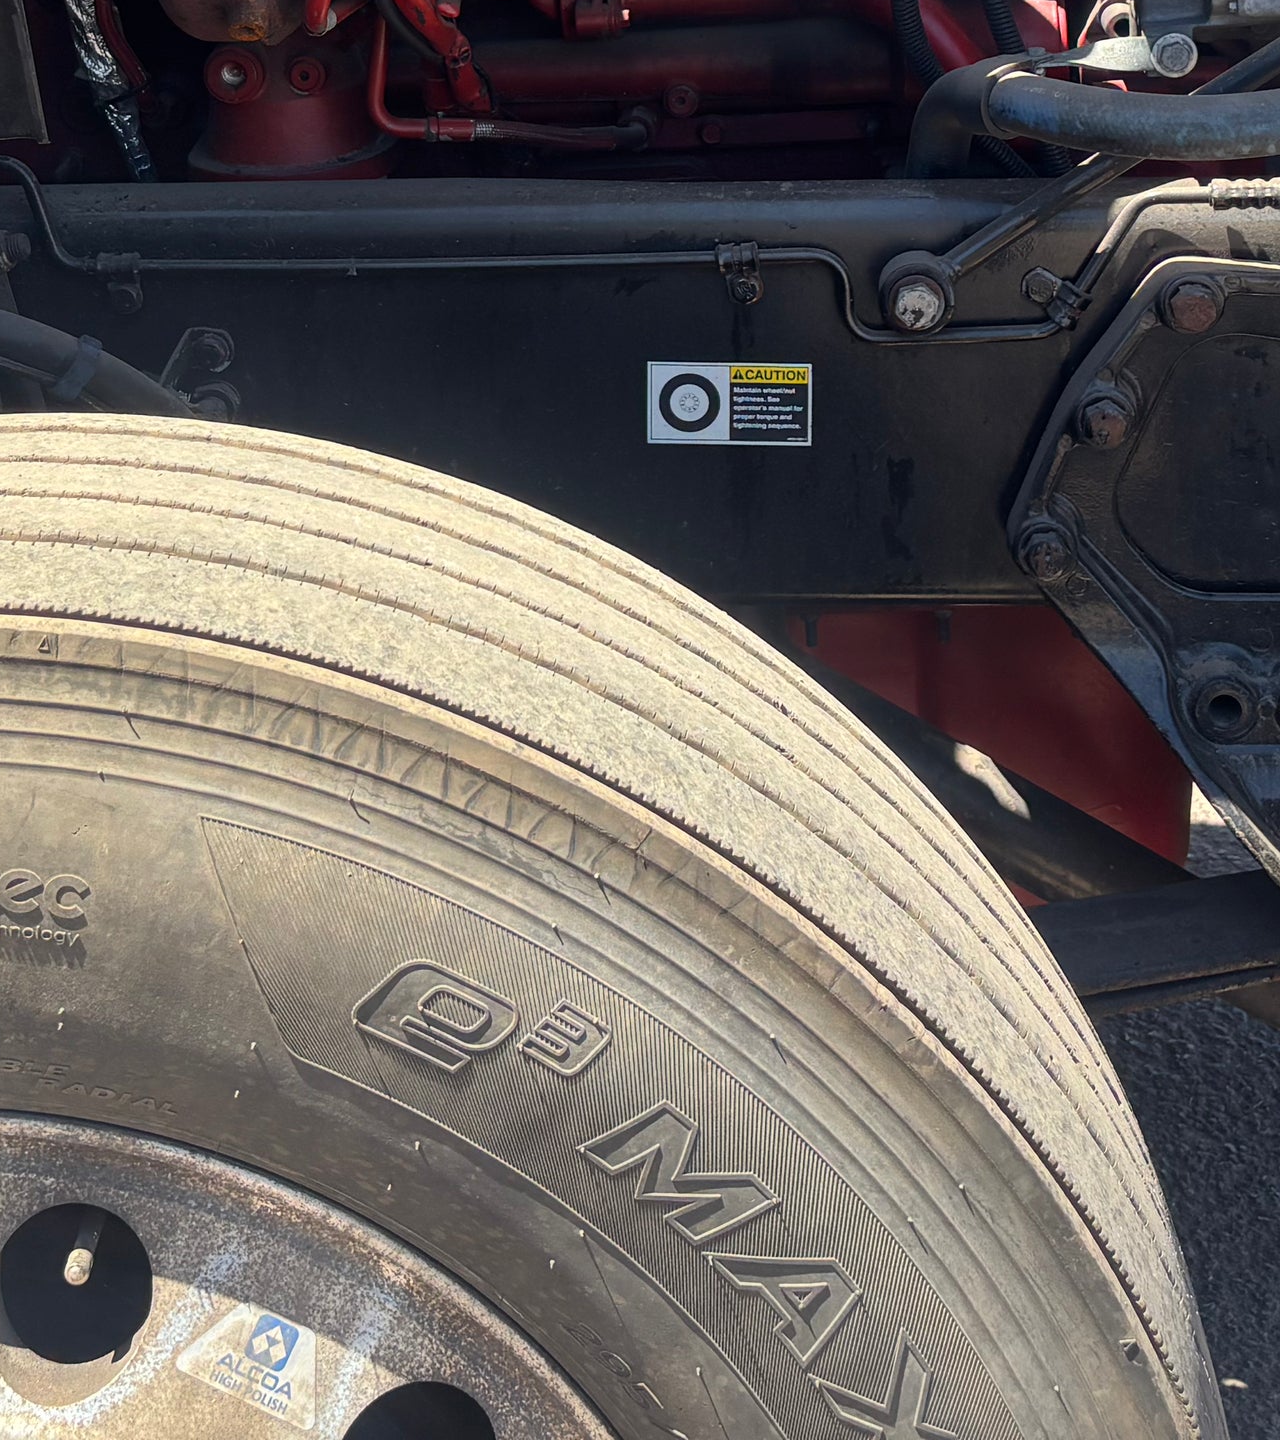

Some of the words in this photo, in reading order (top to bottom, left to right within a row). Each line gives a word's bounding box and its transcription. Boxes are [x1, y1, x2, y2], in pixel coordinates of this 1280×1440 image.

[745, 369, 806, 381] CAUTION
[37, 1077, 178, 1117] RADIAL
[209, 1369, 243, 1393] HIGH
[243, 1386, 289, 1416] POLISH
[215, 1352, 292, 1401] ALCOA
